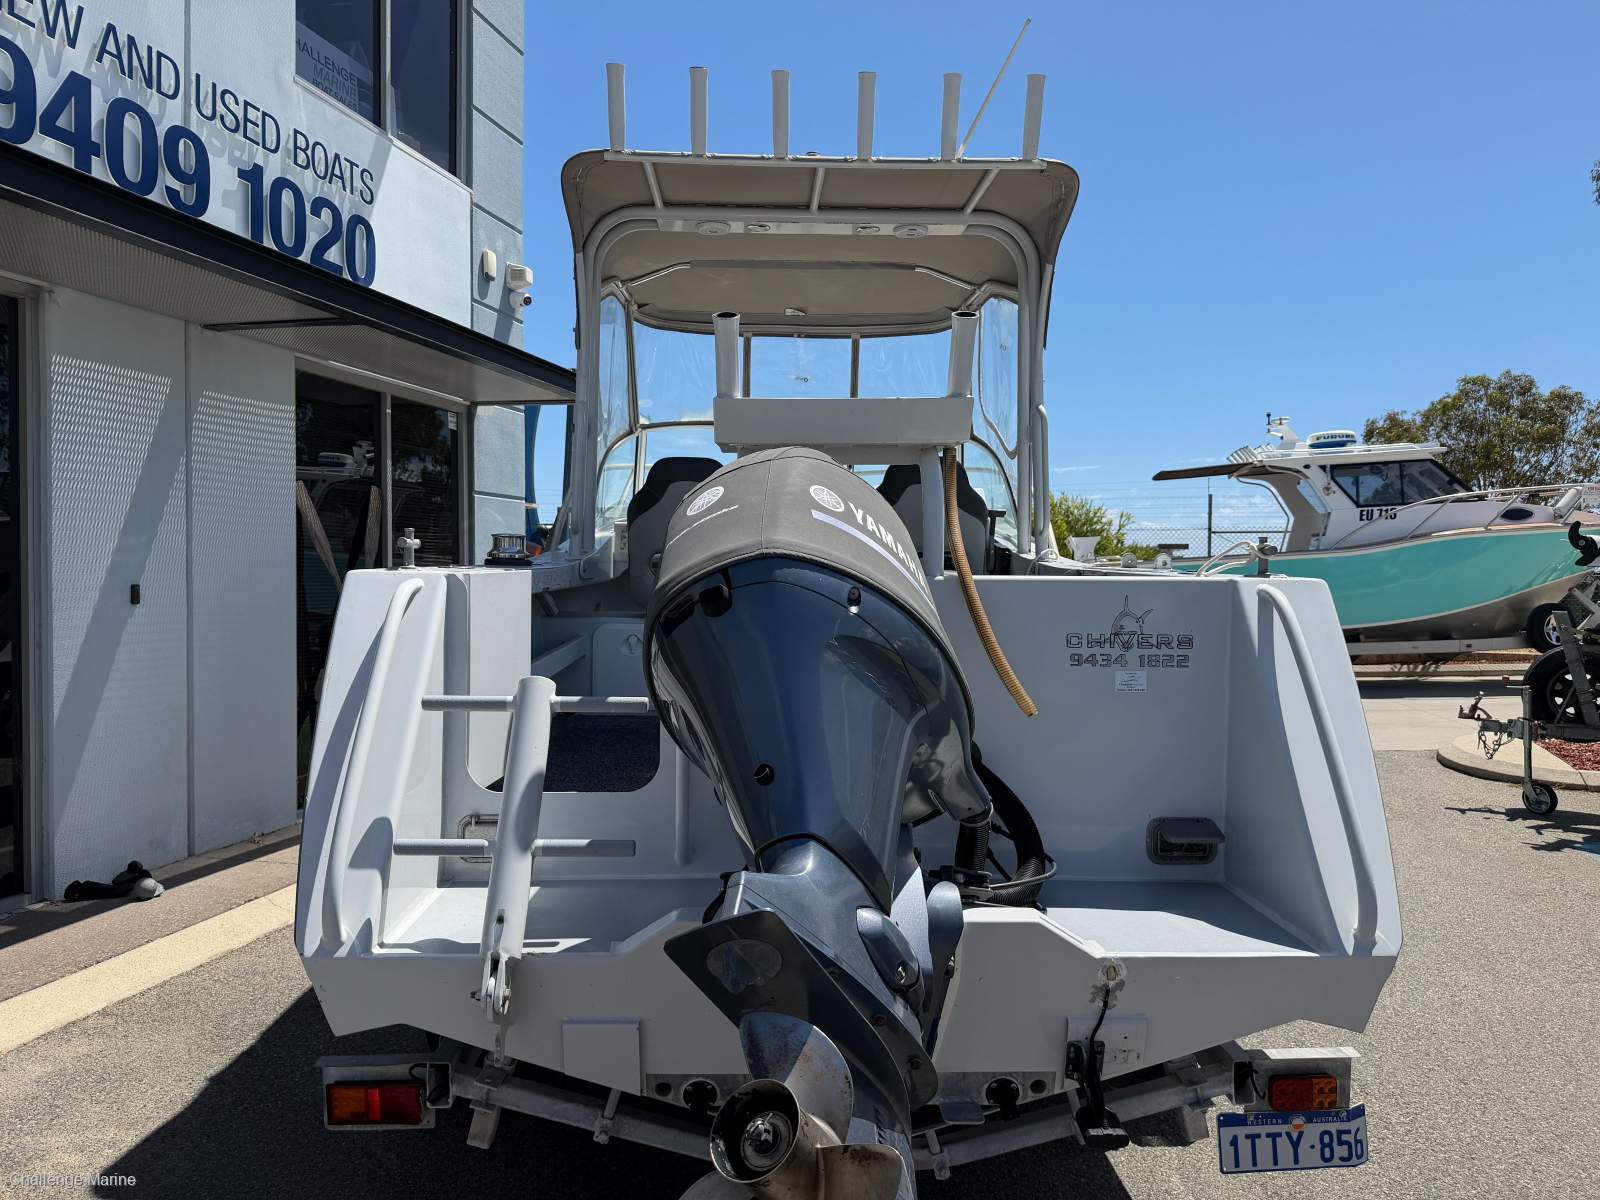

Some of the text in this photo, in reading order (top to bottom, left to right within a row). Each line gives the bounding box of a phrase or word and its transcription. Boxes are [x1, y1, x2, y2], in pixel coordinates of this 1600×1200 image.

[313, 63, 357, 99] MARINE
[0, 0, 375, 206] EW AND USED BOATS
[0, 33, 376, 289] 9409 1020
[1359, 508, 1374, 521] EU
[1066, 632, 1194, 651] CHIVERS
[1070, 653, 1190, 669] 9434 1822
